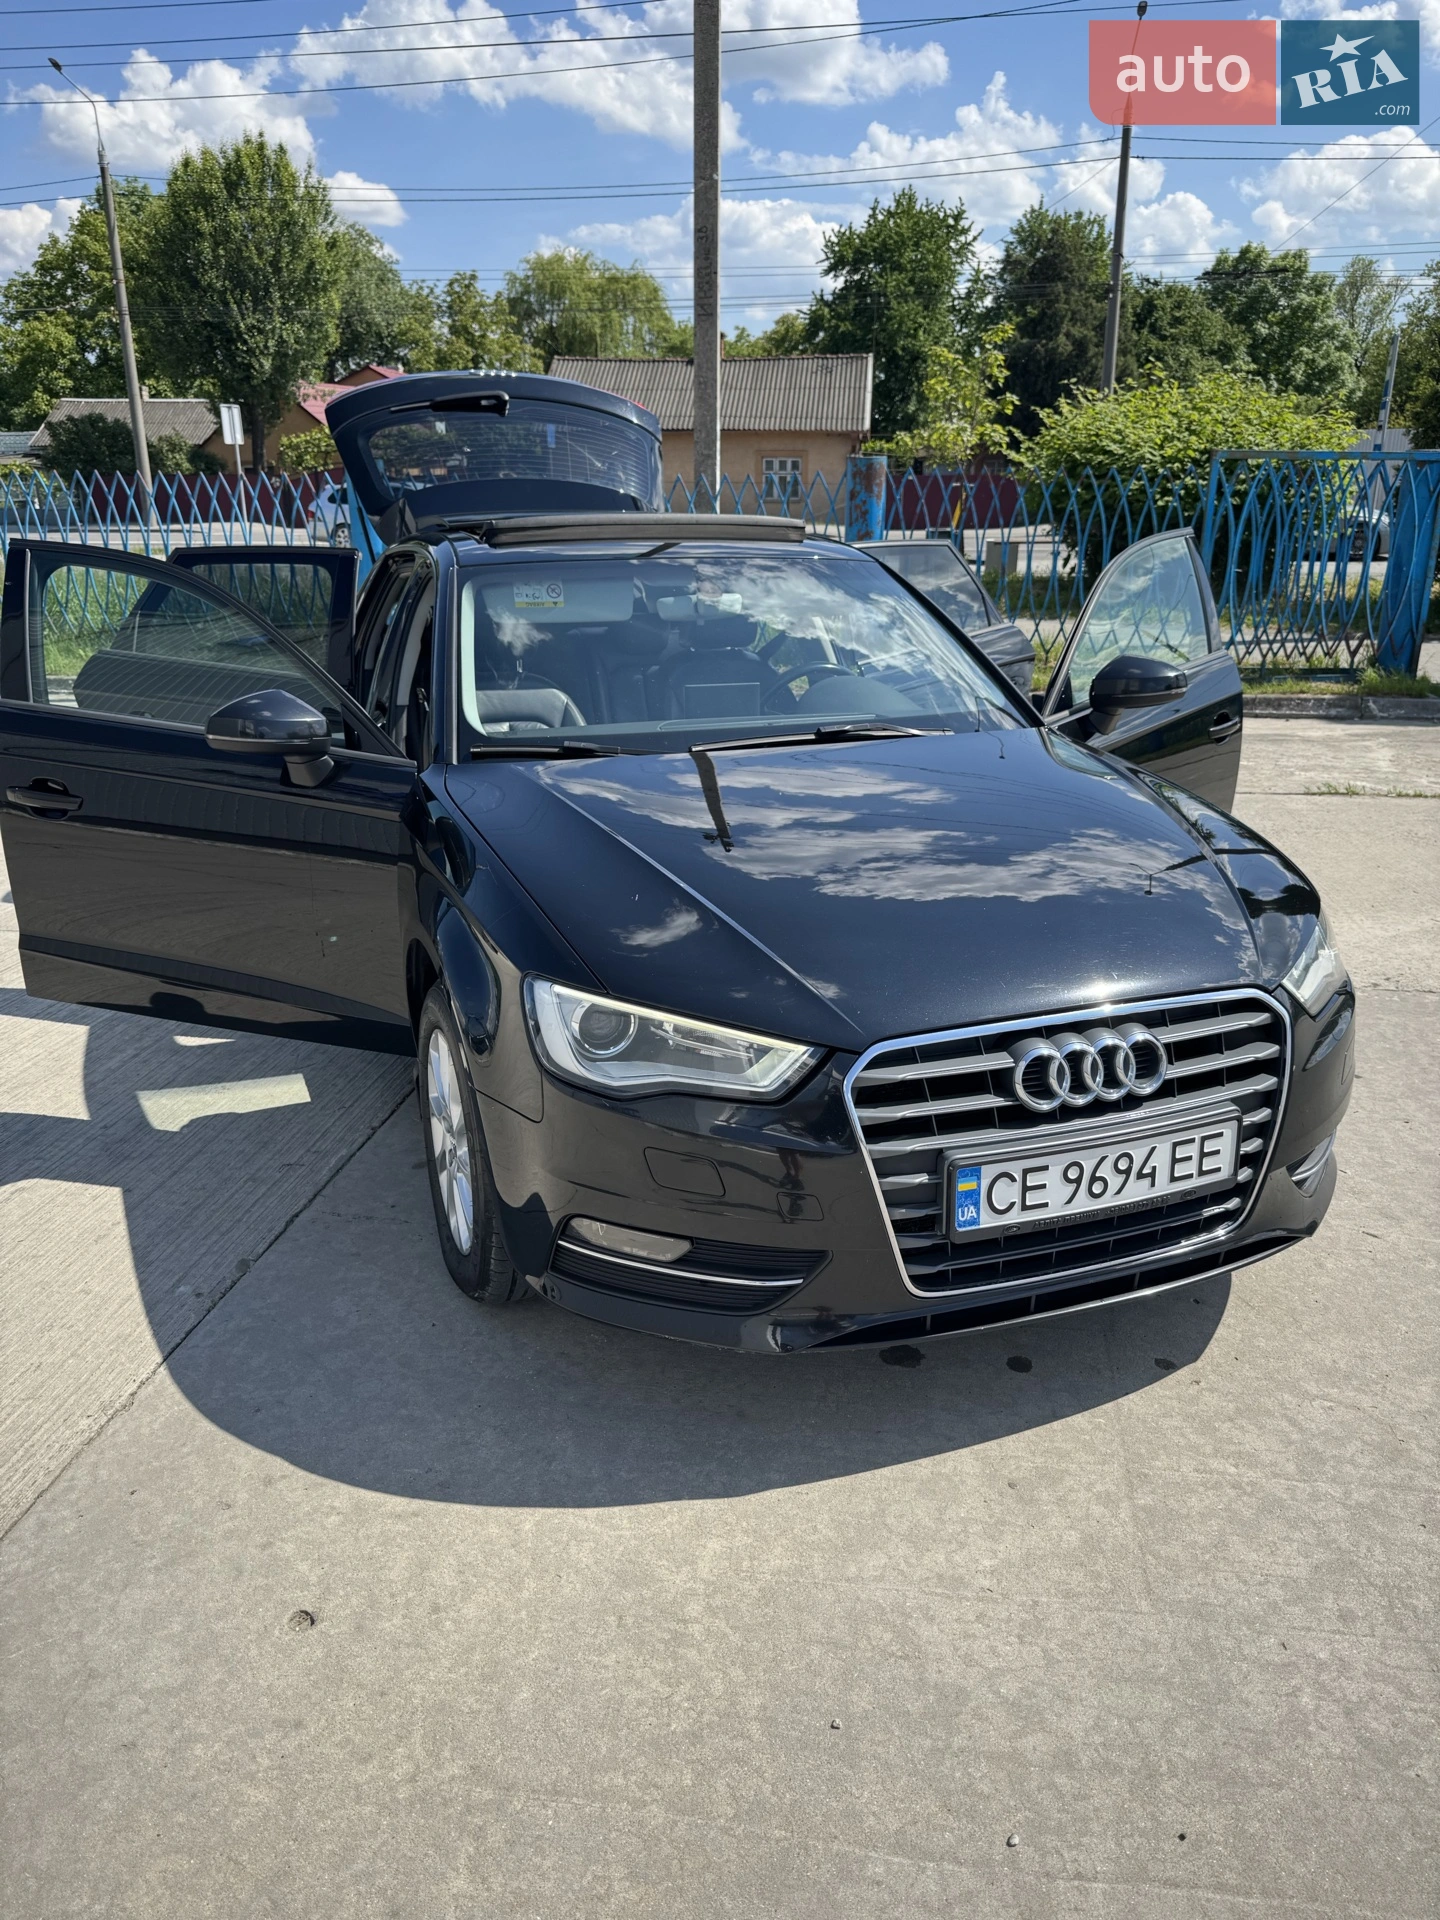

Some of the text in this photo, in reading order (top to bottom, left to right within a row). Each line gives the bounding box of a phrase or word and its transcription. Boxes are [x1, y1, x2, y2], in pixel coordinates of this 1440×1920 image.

[986, 1131, 1225, 1215] CE 9694 EE
[958, 1205, 977, 1222] UA
